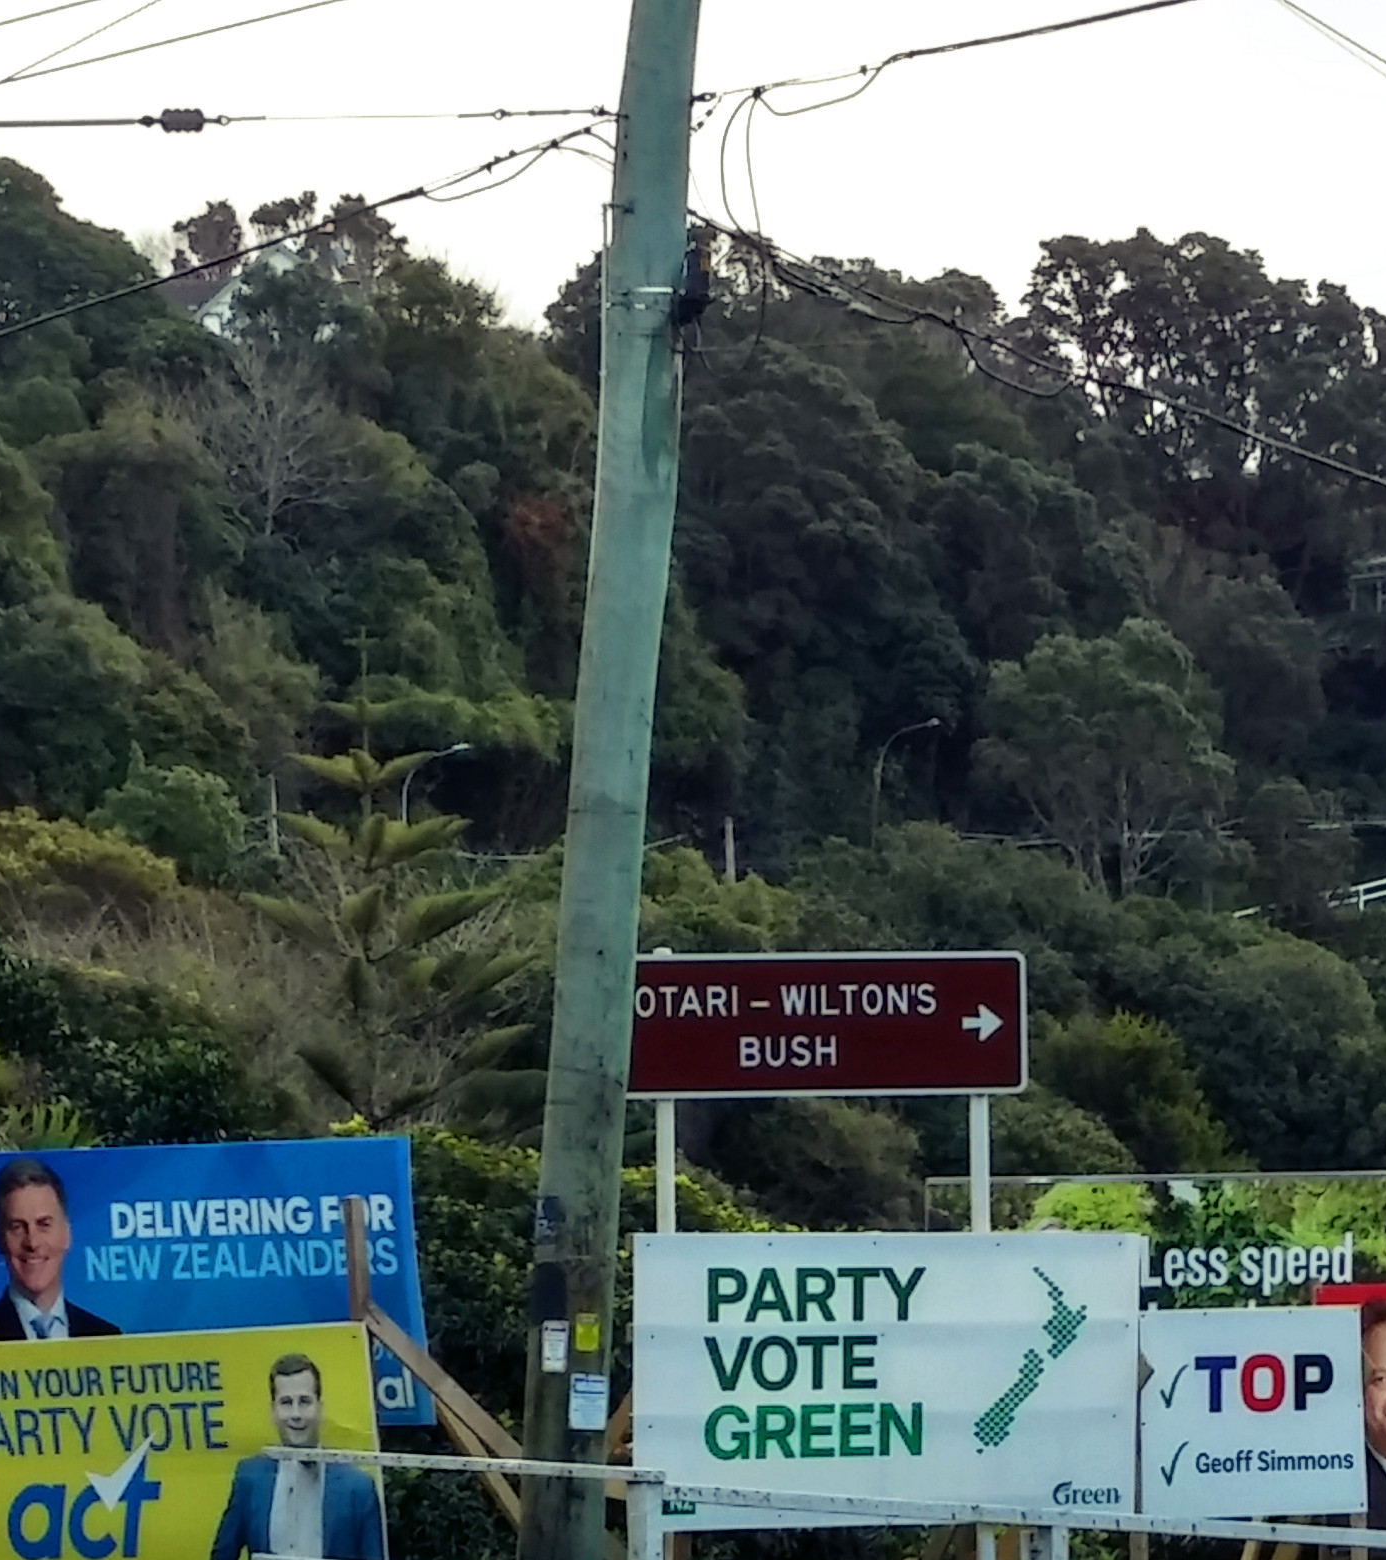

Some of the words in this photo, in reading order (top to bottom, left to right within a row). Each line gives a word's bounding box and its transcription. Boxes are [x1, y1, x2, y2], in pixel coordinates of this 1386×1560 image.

[634, 985, 740, 1018] OTARI
[780, 983, 938, 1016] WILTON'S
[738, 1034, 838, 1068] BUSH
[110, 1196, 313, 1239] DELIVERING
[320, 1194, 396, 1234] FR
[85, 1245, 162, 1282] NEW
[1140, 1235, 1230, 1288] Less
[1240, 1231, 1354, 1297] speed
[707, 1267, 926, 1322] PARTY
[25, 1366, 104, 1398] YOUR
[110, 1360, 224, 1395] FUTURE
[703, 1335, 878, 1391] VOTE
[1194, 1353, 1334, 1413] TOP
[109, 1401, 229, 1452] VOTE
[704, 1402, 923, 1460] GREEN
[1195, 1450, 1254, 1474] Geoff
[1257, 1449, 1355, 1472] Simmons
[1052, 1480, 1122, 1506] Green
